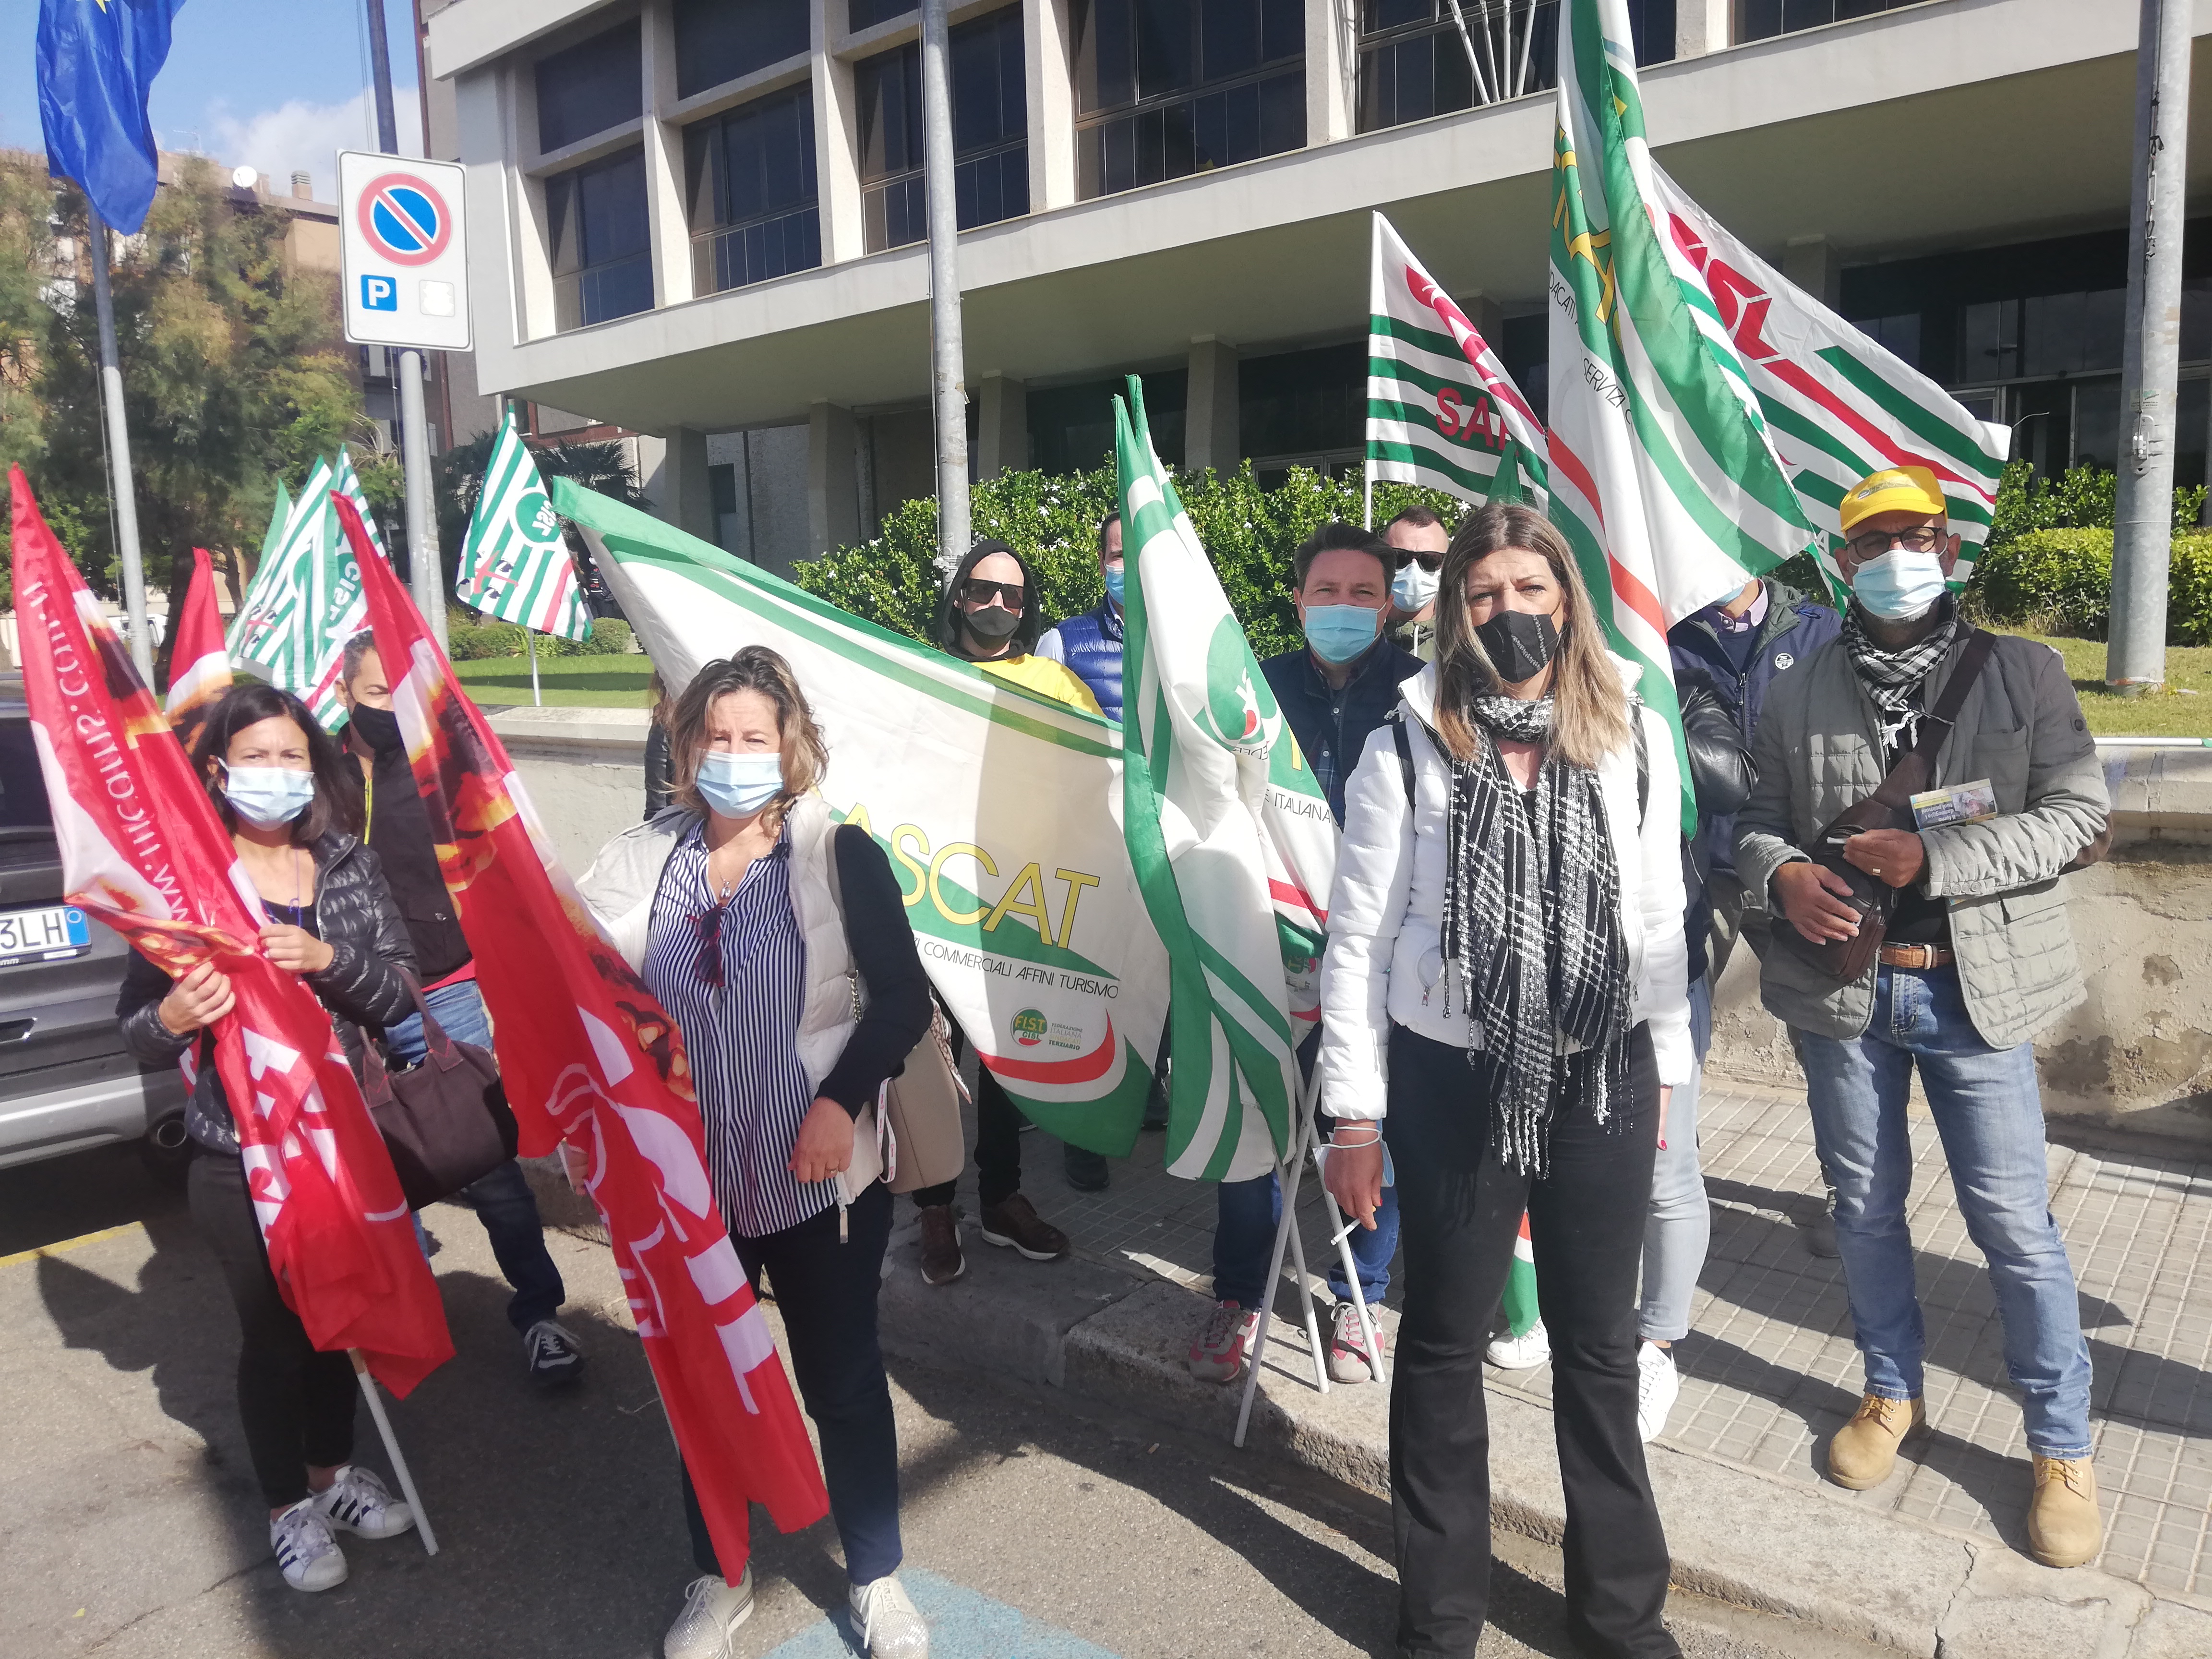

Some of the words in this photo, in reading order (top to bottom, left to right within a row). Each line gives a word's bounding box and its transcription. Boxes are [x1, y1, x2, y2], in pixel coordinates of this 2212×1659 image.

[368, 279, 390, 306] P
[1583, 358, 1626, 408] SERVIZI
[1274, 792, 1331, 823] ITALIANA
[924, 942, 1012, 977] COMMERCIALI
[1015, 966, 1055, 986] AFFINI
[1059, 974, 1119, 999] TURISMO
[1022, 1031, 1041, 1041] CISL
[1050, 1026, 1082, 1039] ITALIANA
[1052, 1022, 1083, 1033] FEDERAZIONE
[1048, 1039, 1081, 1050] TERZIARIO
